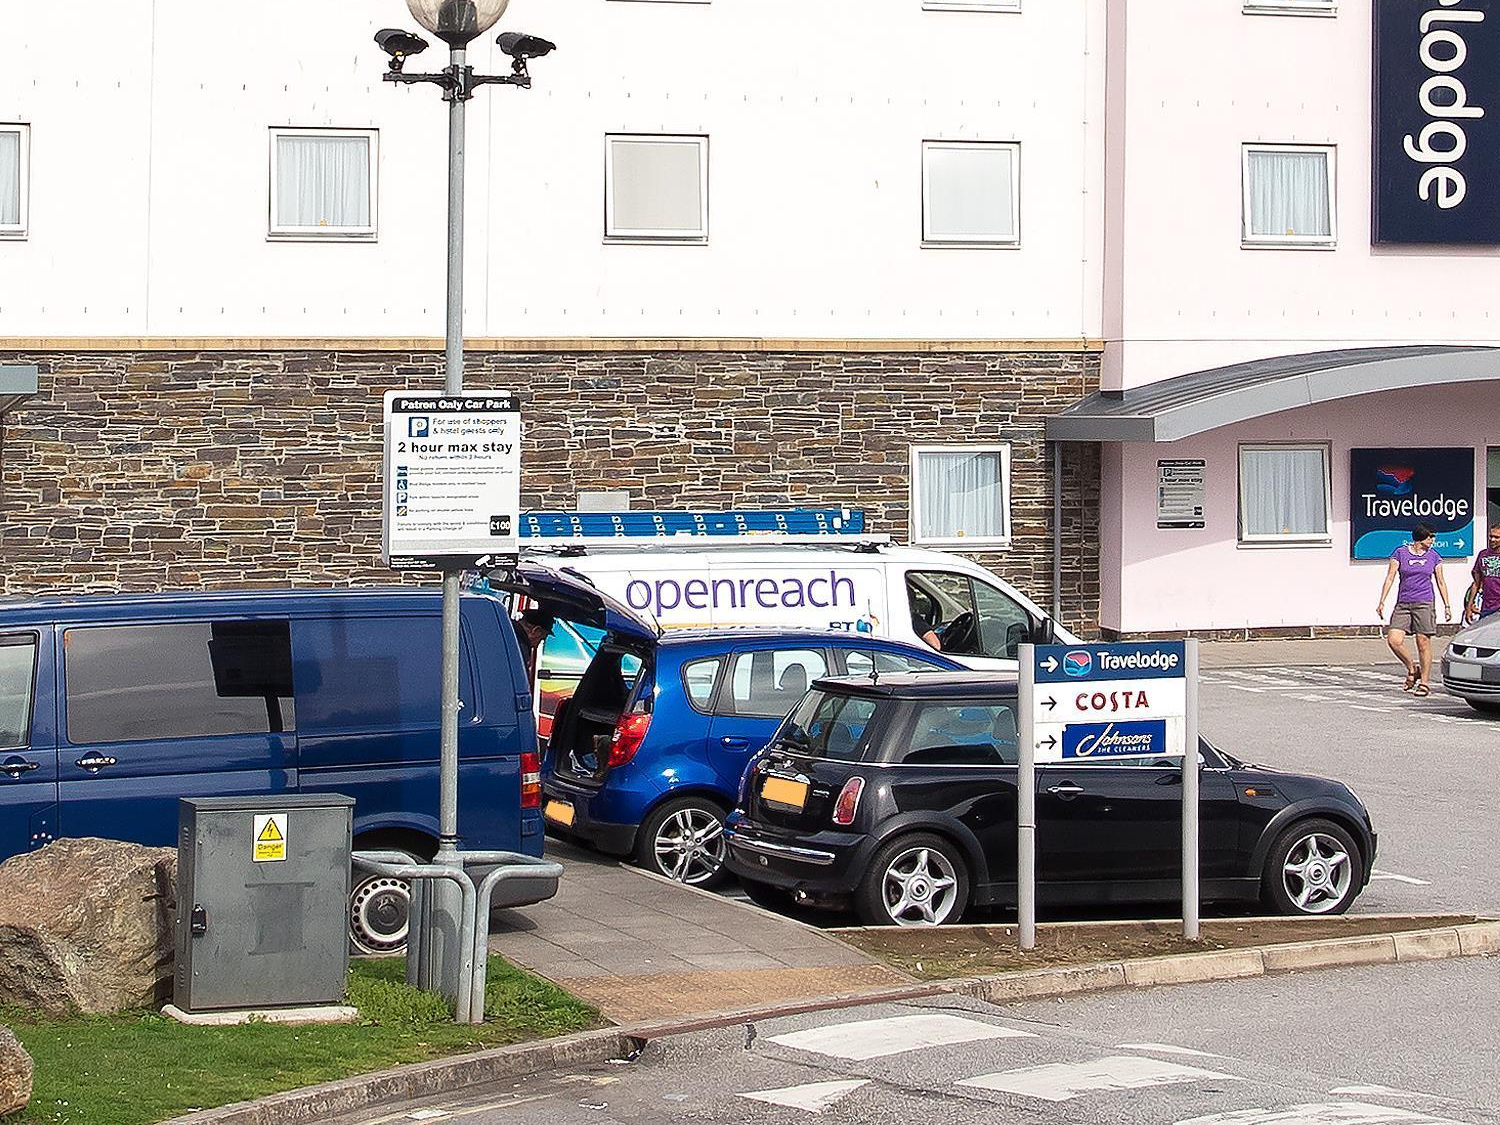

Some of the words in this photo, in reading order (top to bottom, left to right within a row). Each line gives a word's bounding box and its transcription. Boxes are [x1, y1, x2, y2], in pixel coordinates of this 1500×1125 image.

[401, 399, 436, 410] Patron
[464, 399, 484, 409] Car
[485, 399, 511, 409] Park
[397, 441, 406, 453] 2
[411, 442, 444, 453] hour
[448, 443, 478, 453] max
[482, 441, 513, 455] stay
[1361, 493, 1469, 521] Travelodge
[490, 521, 511, 531] £100
[625, 570, 856, 617] openreach
[1096, 650, 1179, 671] Travelodge
[1075, 690, 1149, 712] COSTA
[1075, 722, 1153, 757] Johnsons
